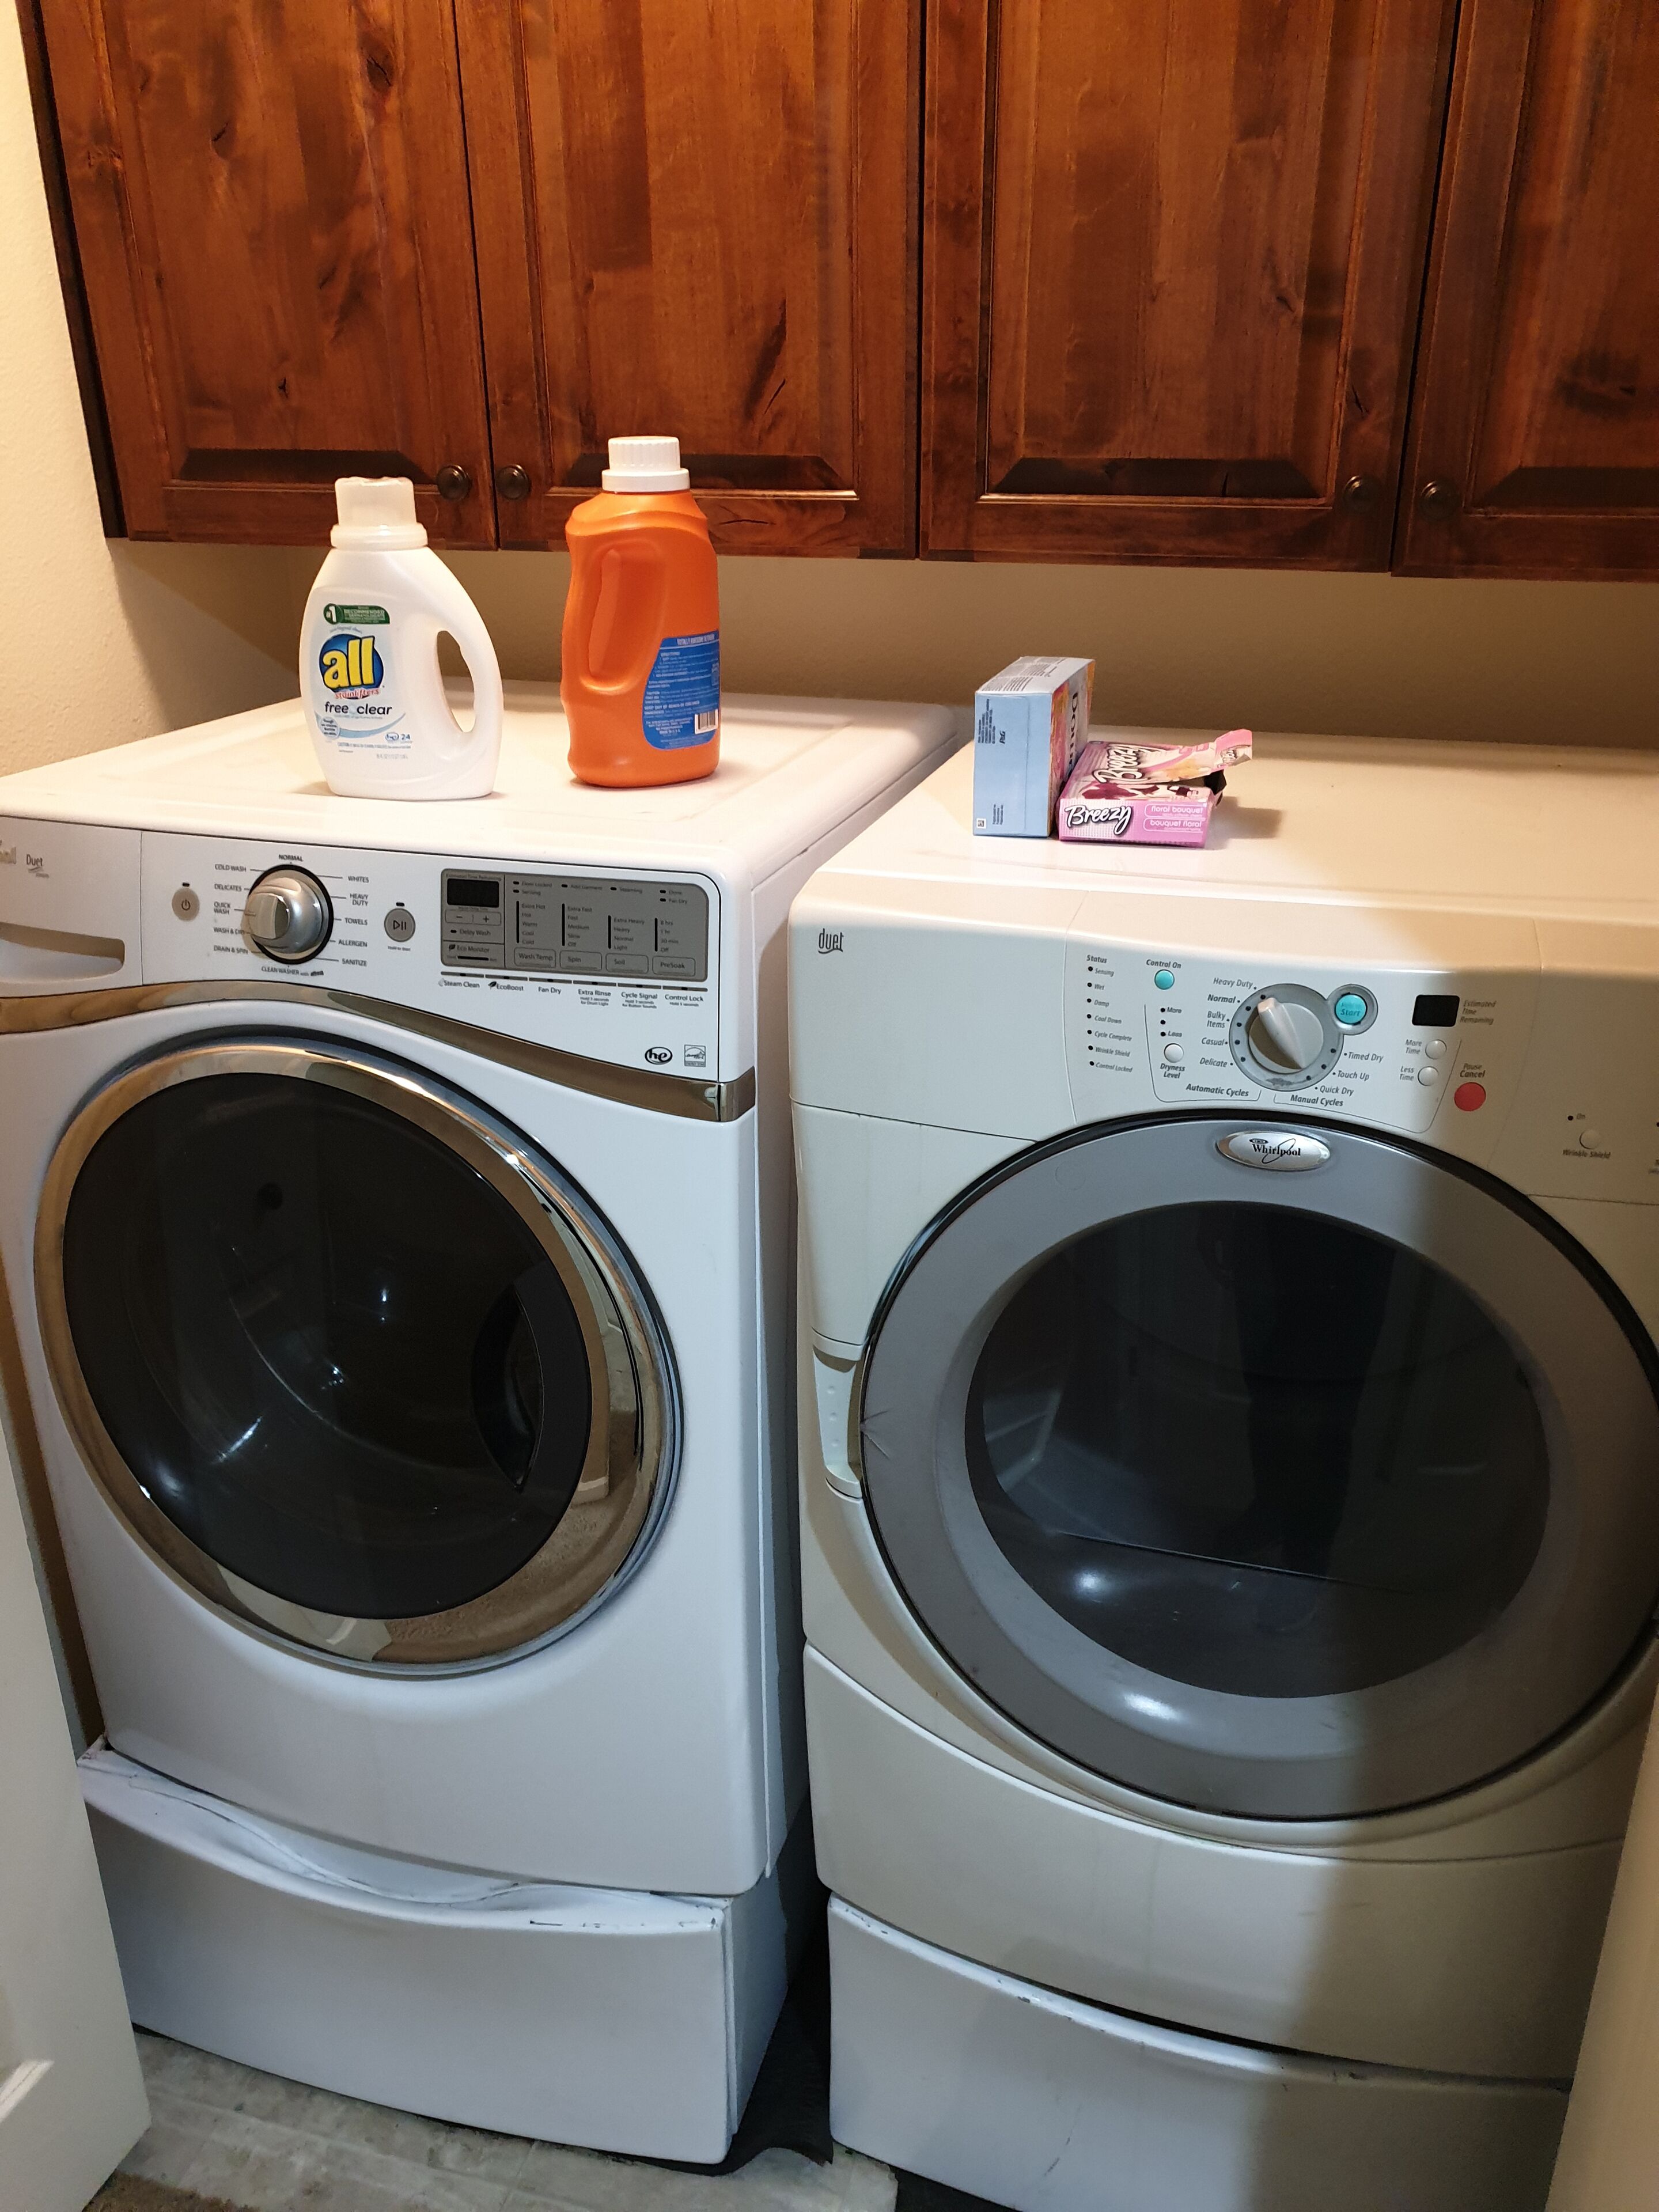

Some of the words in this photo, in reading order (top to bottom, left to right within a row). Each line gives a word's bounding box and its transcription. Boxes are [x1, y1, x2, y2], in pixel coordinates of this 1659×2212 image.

[321, 636, 375, 689] all
[325, 701, 349, 714] free
[357, 703, 392, 715] clear
[1092, 743, 1167, 783] Breezy
[1172, 806, 1203, 814] bouquet
[1065, 805, 1132, 835] Breezy
[1150, 819, 1181, 827] bouquet
[214, 883, 242, 892] DELICATES
[344, 917, 368, 926] TOWELS
[338, 939, 368, 947] ALLERGEN
[818, 928, 844, 950] duet
[342, 958, 367, 967] SANITIZE
[536, 954, 553, 962] Temp
[1086, 955, 1107, 964] Status
[1146, 959, 1171, 968] Control
[1095, 968, 1115, 978] Sensing
[1213, 978, 1235, 987] Heavy
[1236, 979, 1253, 990] Duty
[1094, 999, 1109, 1007] Damp
[1207, 994, 1236, 1003] Normal
[1463, 999, 1497, 1007] Estimated
[1207, 1010, 1226, 1021] Bulky
[1340, 1009, 1360, 1017] Start
[1207, 1020, 1225, 1028] Items
[1460, 1016, 1494, 1025] Remaining
[1109, 1033, 1132, 1041] Complete
[1201, 1037, 1225, 1046] Casual
[1405, 1039, 1422, 1047] More
[647, 1048, 669, 1063] he
[1095, 1047, 1114, 1055] Wrinkle
[1348, 1051, 1370, 1060] Timed
[1371, 1054, 1384, 1063] Dry
[1199, 1057, 1228, 1067] Delicate
[1115, 1065, 1132, 1073] Locked
[1160, 1063, 1185, 1071] Dryness
[1337, 1070, 1358, 1079] Touch
[1359, 1073, 1370, 1082] Up
[1460, 1070, 1486, 1078] Cancel
[1185, 1084, 1225, 1094] Automatic
[1226, 1088, 1249, 1097] Cycles
[1320, 1085, 1340, 1094] Quick
[1341, 1087, 1354, 1097] Dry
[1290, 1094, 1319, 1104] Manual
[1320, 1097, 1343, 1107] Cycles
[1252, 1143, 1301, 1157] Whirlpool
[1590, 1151, 1611, 1159] Shield
